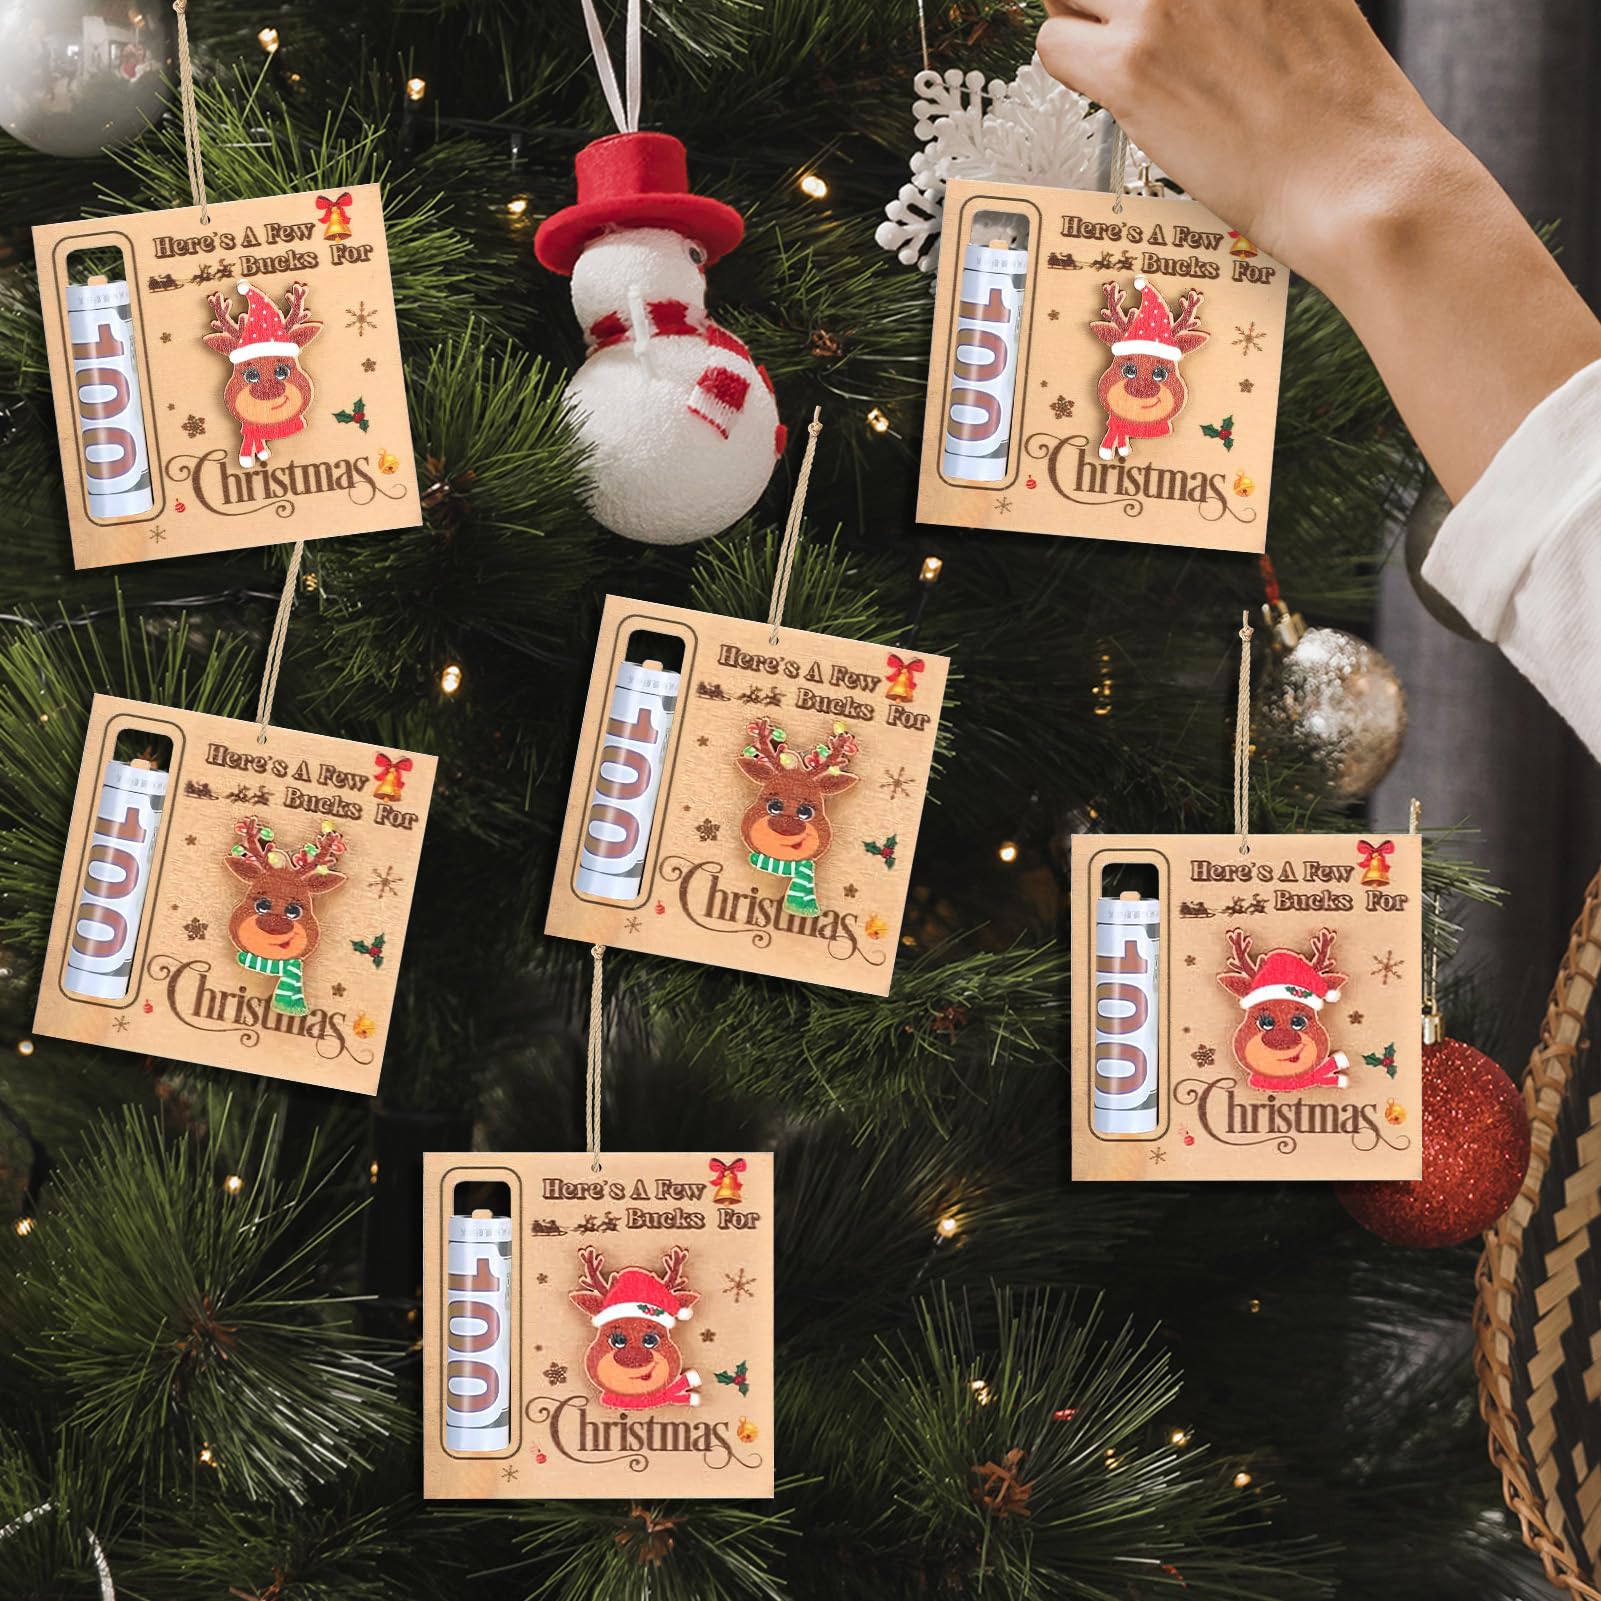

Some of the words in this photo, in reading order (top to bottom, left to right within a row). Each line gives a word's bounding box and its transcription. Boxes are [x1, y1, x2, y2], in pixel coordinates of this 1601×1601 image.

[153, 231, 235, 260] Here's
[241, 225, 261, 249] A
[265, 221, 316, 244] Few
[1060, 215, 1143, 244] Here's
[1148, 223, 1168, 246] A
[1173, 225, 1224, 251] Few
[239, 249, 319, 278] Bucks
[330, 241, 374, 267] For
[1141, 251, 1220, 280] Bucks
[1232, 260, 1276, 284] For
[946, 288, 1011, 442] 100
[71, 323, 137, 480] 100
[165, 449, 407, 518] Christmas
[1024, 432, 1257, 523] Christmas
[716, 643, 799, 679] Here's
[804, 660, 824, 684] A
[828, 664, 883, 695] Few
[795, 687, 875, 722] Bucks
[886, 704, 931, 732] For
[205, 742, 288, 778] Here's
[292, 759, 312, 783] A
[316, 762, 370, 793] Few
[583, 708, 658, 859] 100
[283, 785, 363, 821] Bucks
[374, 802, 419, 831] For
[71, 807, 147, 958] 100
[1190, 860, 1273, 883] Here's
[1278, 860, 1299, 883] A
[1302, 860, 1355, 884] Few
[1274, 889, 1354, 913] Bucks
[1365, 890, 1408, 913] For
[1095, 940, 1149, 1095] 100
[1173, 1076, 1411, 1154] Christmas
[542, 1178, 625, 1201] Here's
[630, 1178, 651, 1201] A
[654, 1178, 707, 1202] Few
[625, 1207, 706, 1230] Bucks
[717, 1208, 761, 1231] For
[447, 1257, 501, 1413] 100
[525, 1395, 763, 1472] Christmas
